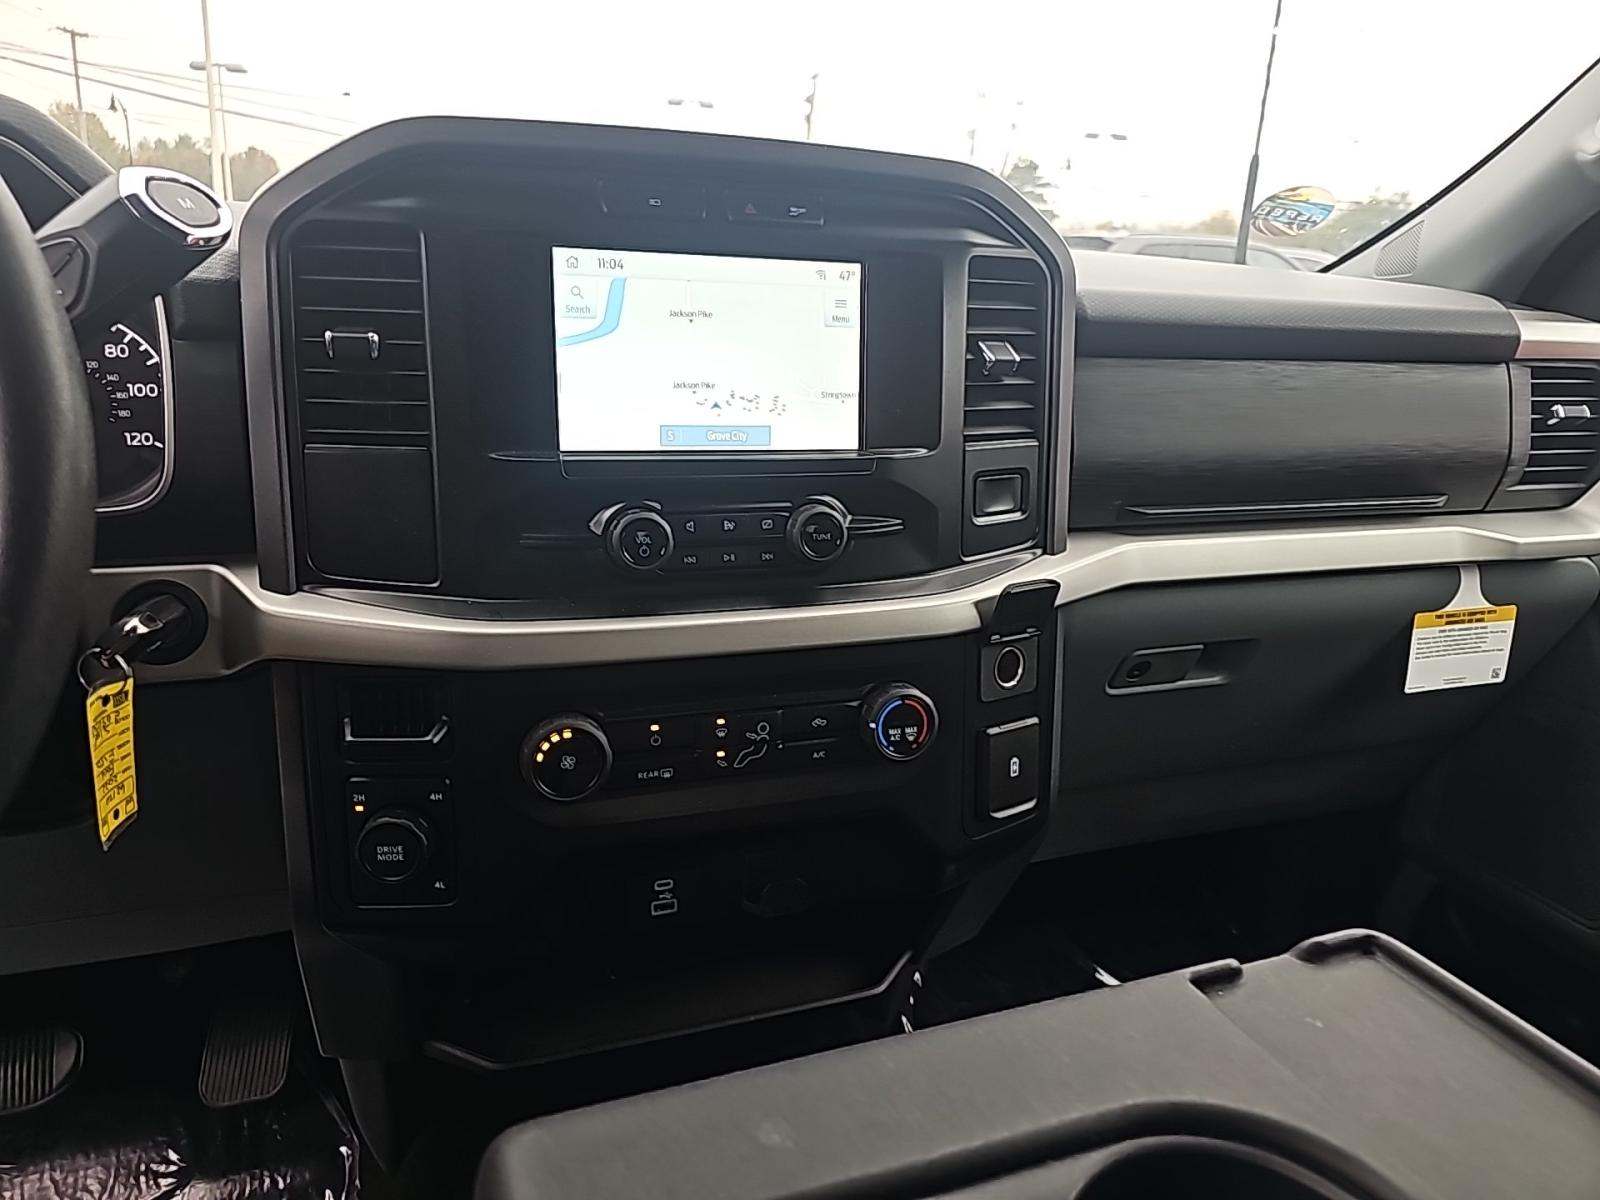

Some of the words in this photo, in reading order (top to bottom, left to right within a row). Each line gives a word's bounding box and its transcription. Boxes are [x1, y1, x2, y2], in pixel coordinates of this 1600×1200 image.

[598, 257, 624, 270] 11:04
[565, 304, 591, 315] Search
[832, 314, 850, 324] Menu
[104, 343, 129, 359] 80
[86, 360, 99, 369] 120
[106, 373, 119, 381] 140
[126, 383, 158, 398] 100
[118, 409, 131, 418] 180
[124, 431, 154, 446] 120
[706, 430, 731, 441] Grove
[731, 430, 747, 443] City
[634, 535, 652, 544] VOL
[812, 532, 831, 541] TUNE
[812, 750, 826, 759] A/C
[637, 769, 659, 779] REAR
[352, 794, 366, 802] 2H
[429, 792, 443, 801] 4H
[376, 845, 404, 854] DRIVE
[377, 853, 405, 862] MODE
[434, 880, 446, 889] 4L
